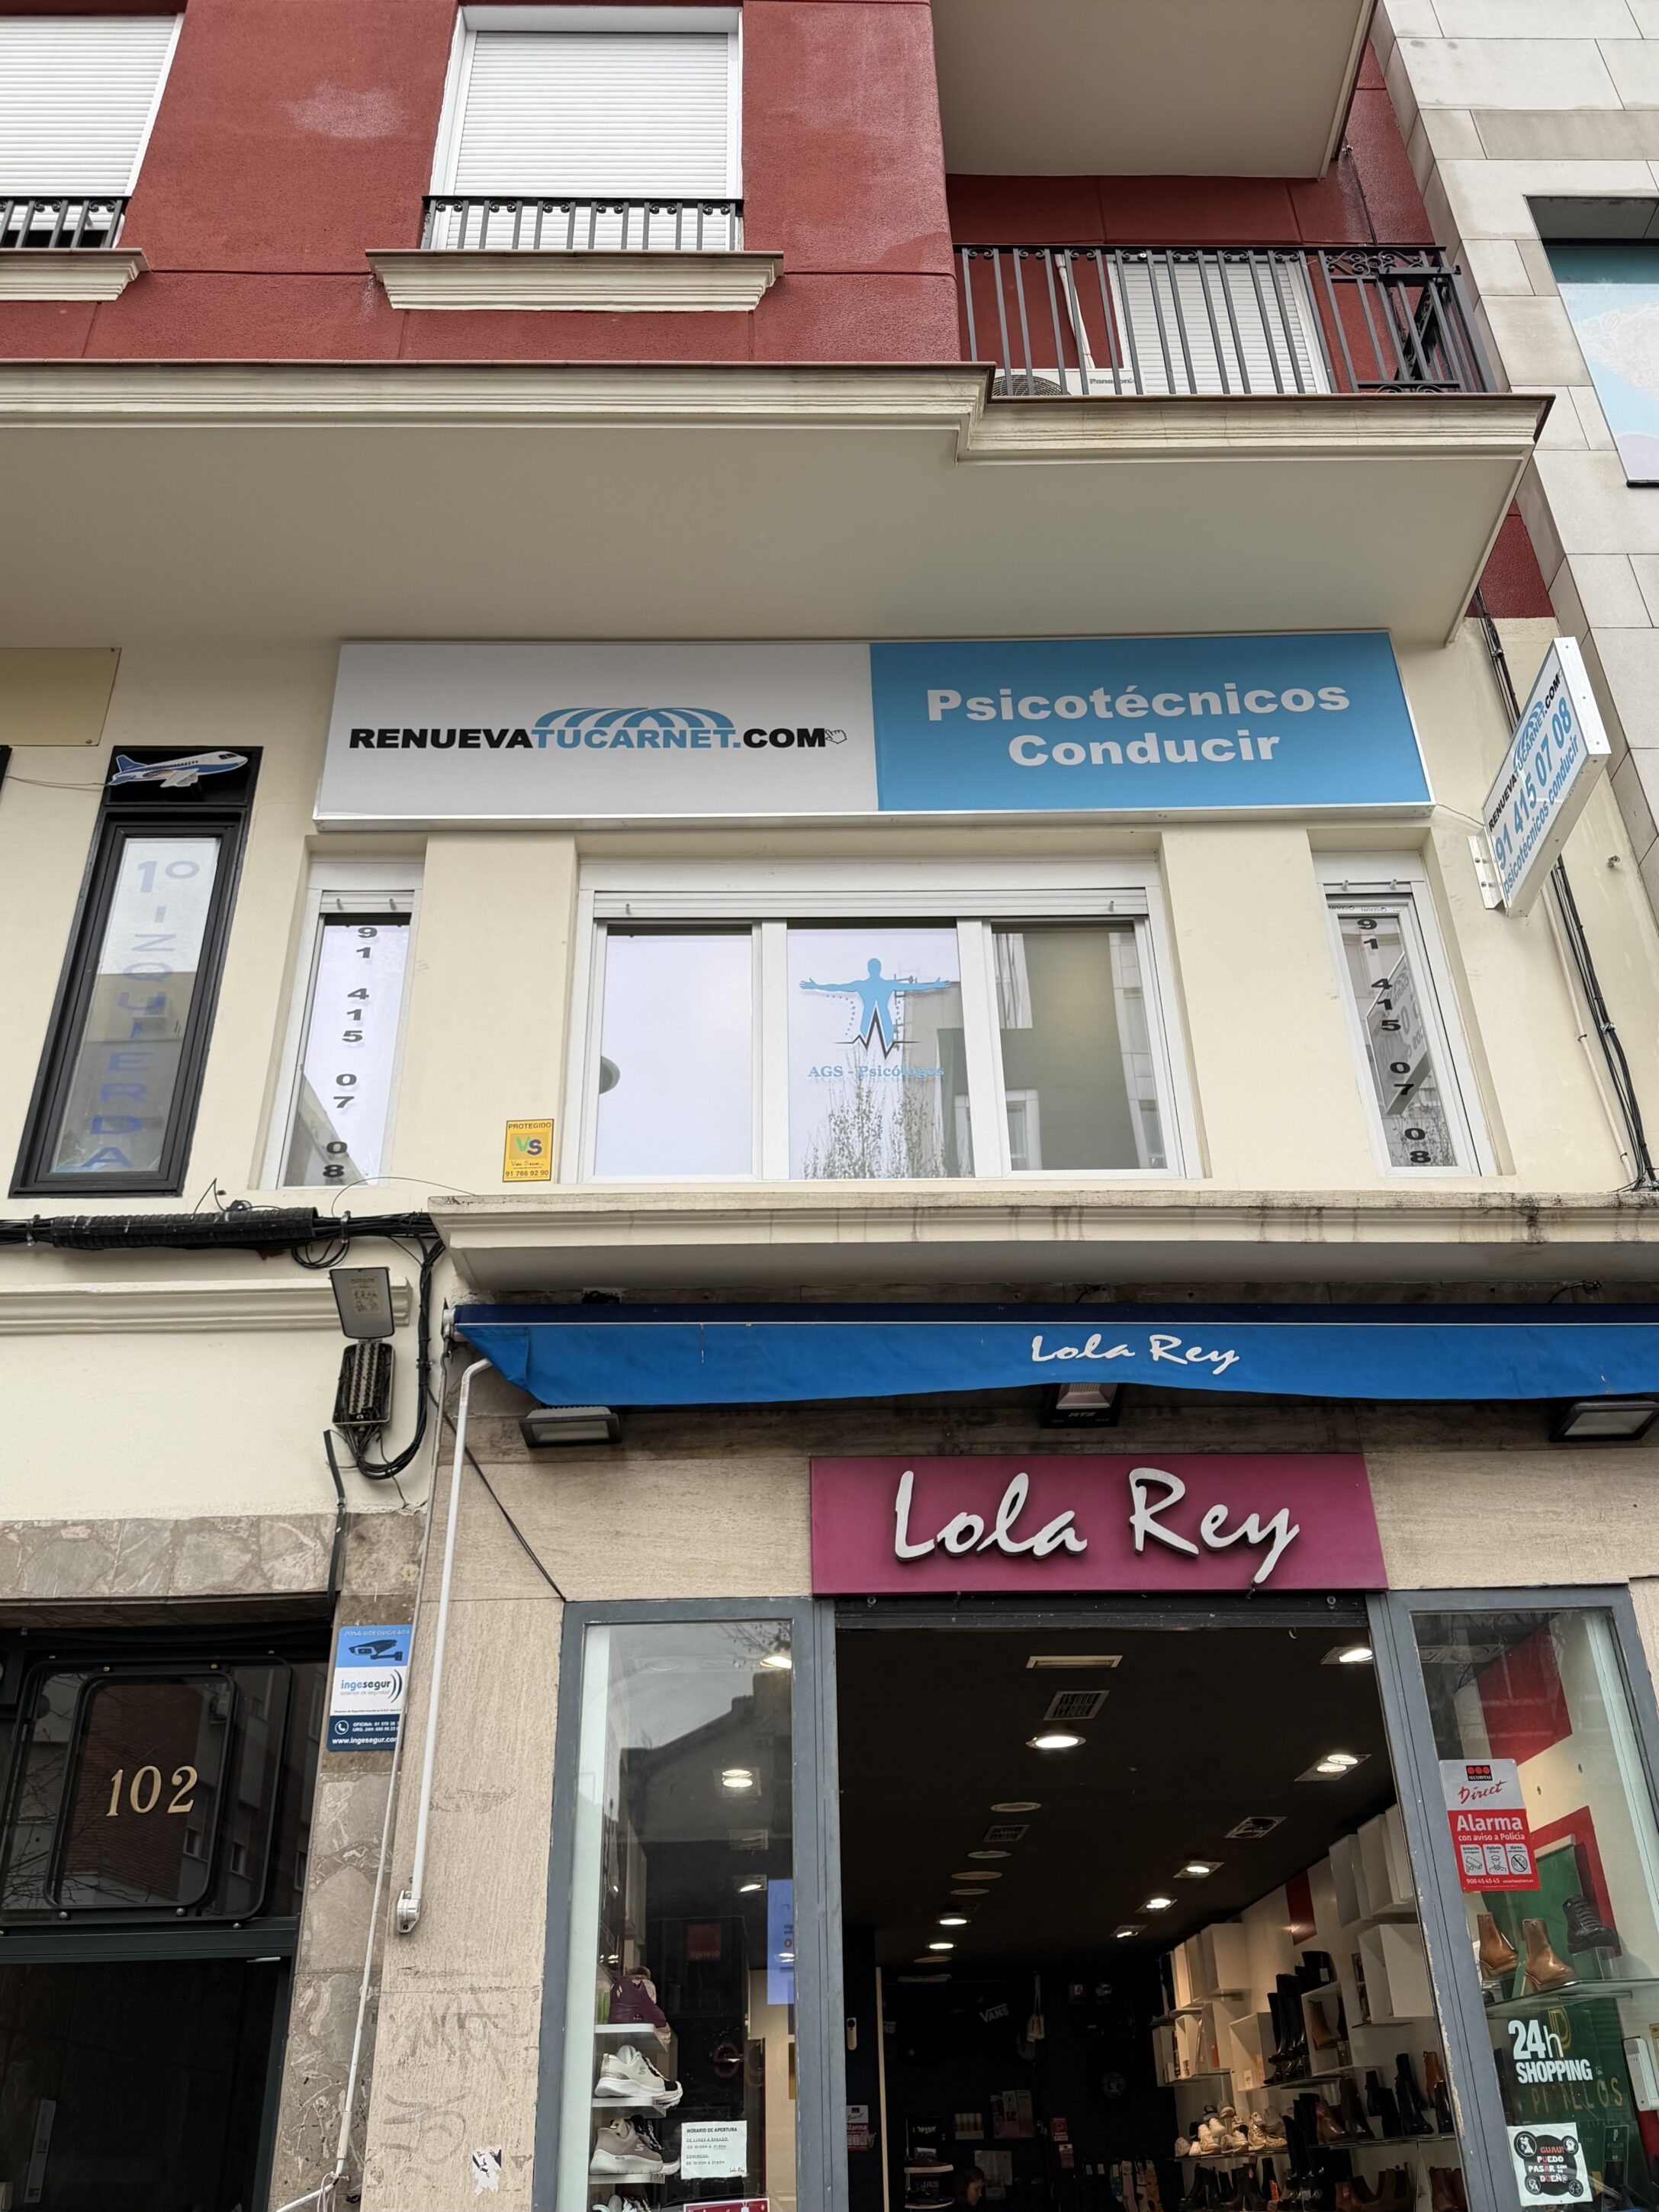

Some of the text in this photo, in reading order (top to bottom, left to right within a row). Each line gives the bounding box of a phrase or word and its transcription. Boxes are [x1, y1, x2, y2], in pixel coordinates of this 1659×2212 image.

[927, 683, 1350, 722] Psicotécnicos
[349, 727, 827, 749] RENUEVATUCARNET.COM
[1008, 729, 1281, 767] Conducir
[1488, 673, 1561, 833] RENUEVATUCARNET.COM
[1496, 697, 1572, 871] 91 415 07 08
[1548, 735, 1579, 805] conducir
[323, 927, 378, 1178] 91 415 07 08
[1357, 918, 1379, 950] 91
[1371, 978, 1401, 1031] 415
[1390, 1062, 1414, 1095] 07
[1404, 1127, 1431, 1163] 08
[808, 1066, 843, 1078] AGS
[858, 1065, 945, 1079] Psicólogos
[1031, 1333, 1240, 1374] Lola Rey
[895, 1467, 1301, 1586] Lola Rey
[341, 1680, 391, 1692] ingesegur
[105, 1765, 198, 1817] 102
[1457, 1780, 1508, 1805] Direct
[1457, 1814, 1523, 1831] Alarma
[1473, 1833, 1493, 1841] aviso
[1500, 1832, 1526, 1841] Policía
[979, 2003, 1010, 2024] VANS
[1508, 2019, 1564, 2060] 24h
[1515, 2059, 1593, 2085] SHOPPING
[1528, 2165, 1555, 2173] PASAR
